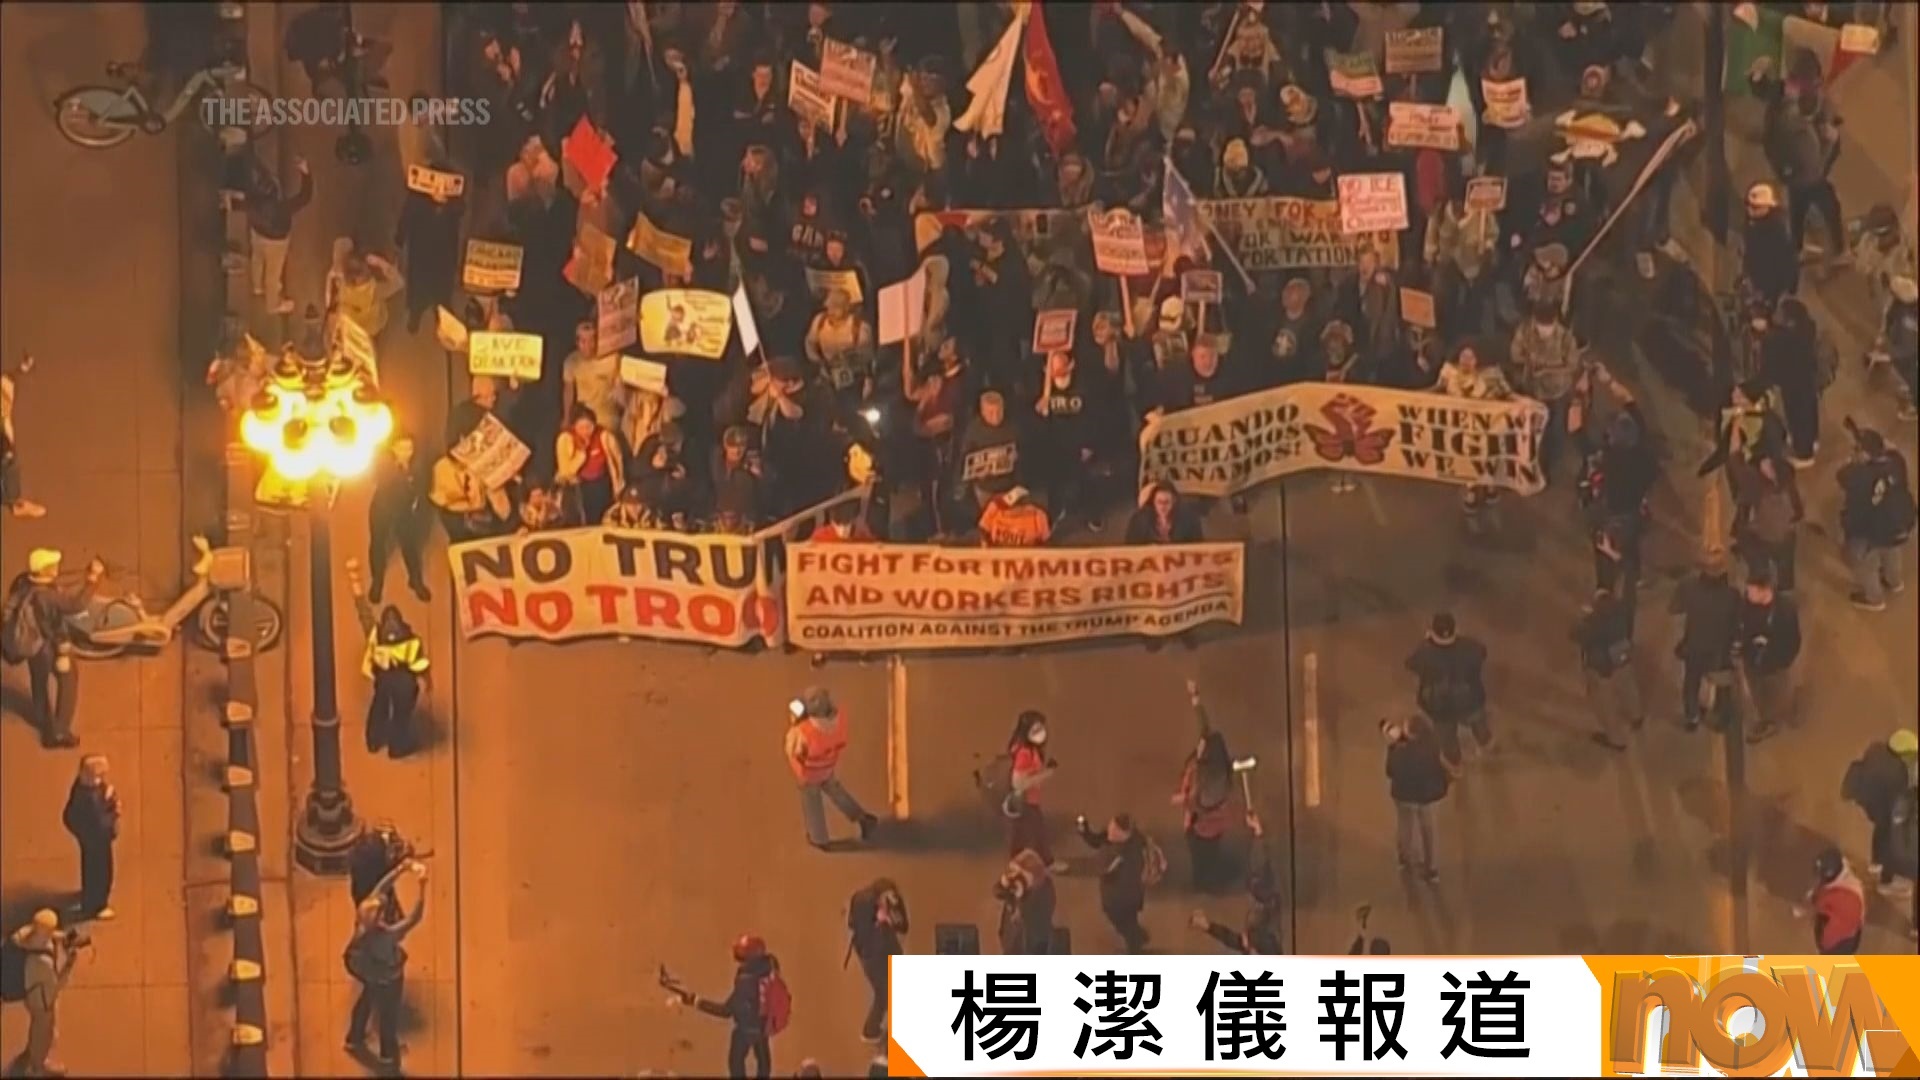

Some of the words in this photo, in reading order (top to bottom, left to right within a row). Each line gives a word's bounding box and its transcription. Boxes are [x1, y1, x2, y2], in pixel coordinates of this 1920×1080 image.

[1204, 202, 1257, 219] ONEY
[1153, 403, 1299, 447] CUANDO
[1397, 403, 1491, 431] WHEN
[1400, 422, 1537, 464] FIGHT
[1401, 449, 1455, 475] WE
[1472, 458, 1537, 485] WIN
[460, 538, 573, 587] NO
[797, 552, 904, 576] FIGHT
[911, 553, 981, 576] FOR
[991, 551, 1234, 581] IMMIGRANTS
[467, 588, 574, 634] NO
[806, 584, 883, 606] AND
[893, 586, 1081, 611] WORKERS
[1091, 571, 1226, 603] RIGHTS
[802, 622, 914, 639] COALITION
[919, 622, 1011, 637] AGAINST
[1020, 621, 1058, 637] THE
[1067, 613, 1139, 632] TRUMP
[1145, 599, 1229, 627] AGENDA
